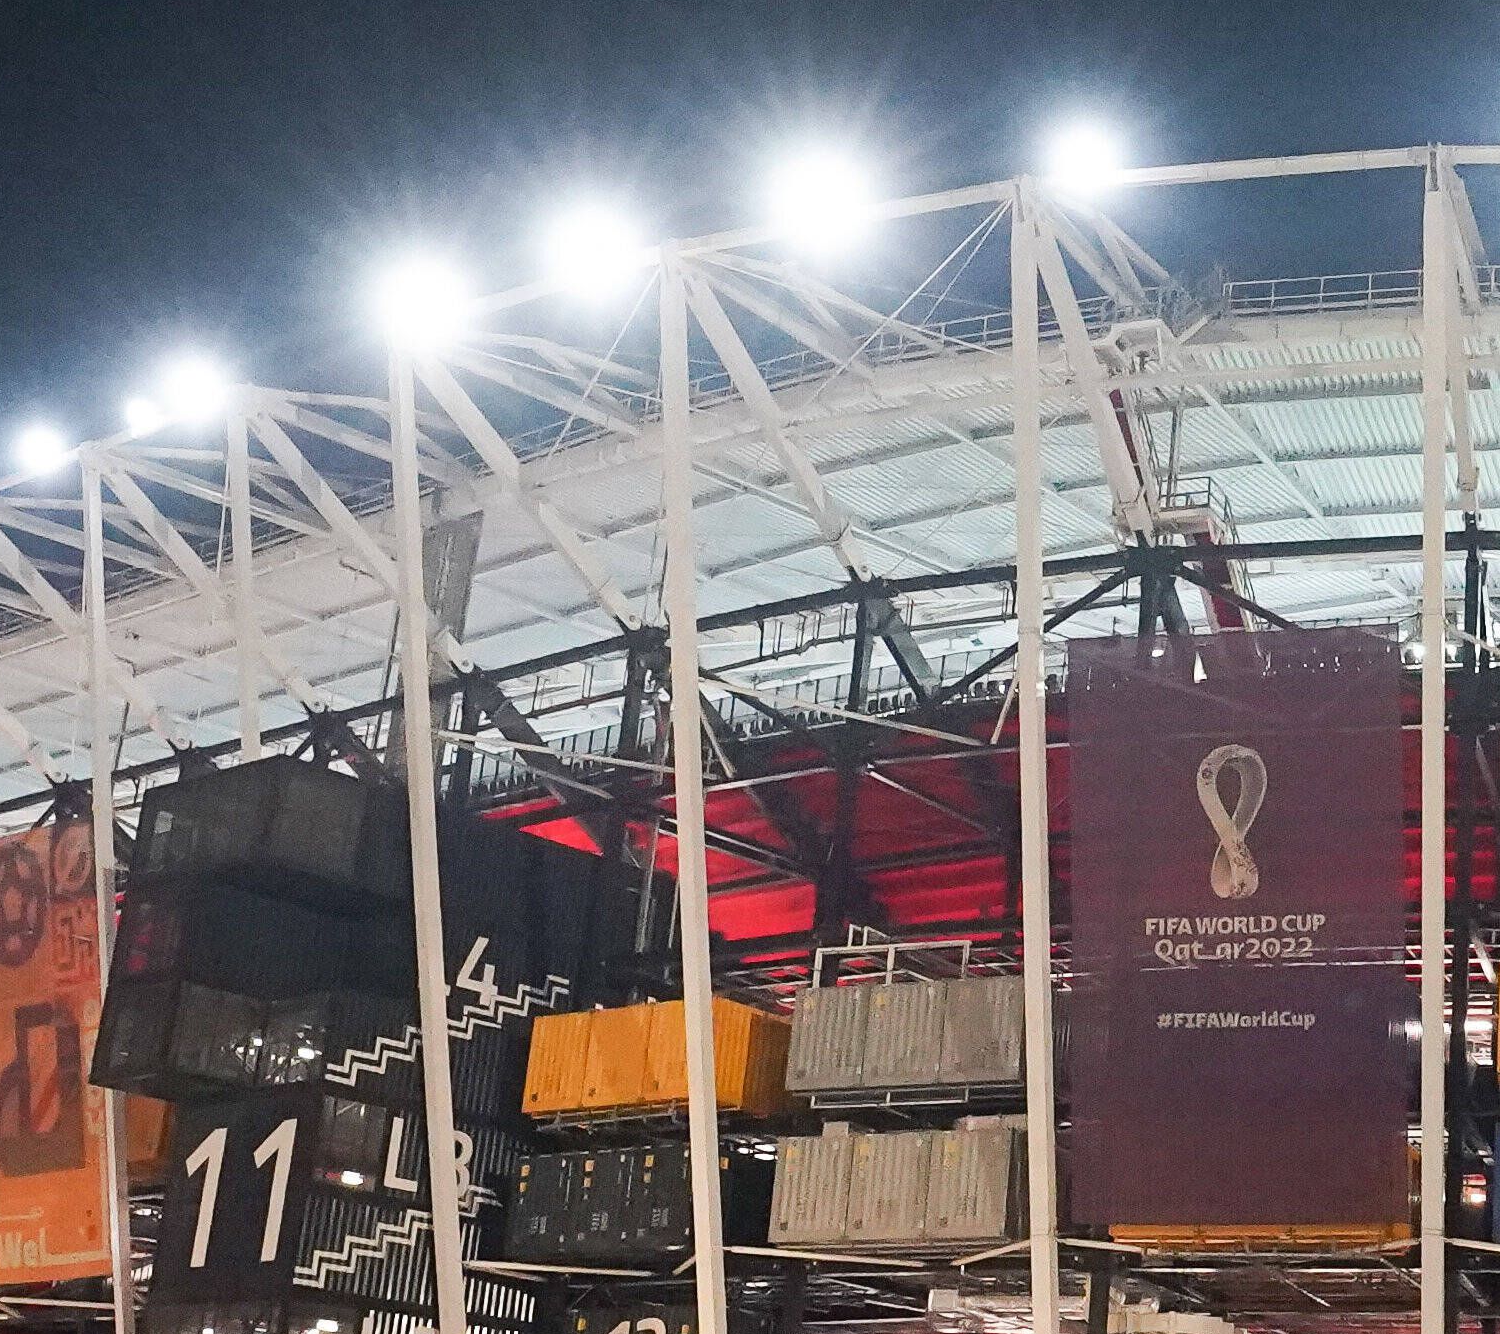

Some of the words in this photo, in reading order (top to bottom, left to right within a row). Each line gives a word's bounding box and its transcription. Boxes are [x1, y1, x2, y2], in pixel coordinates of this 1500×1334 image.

[1145, 917, 1192, 935] FIFA
[1196, 916, 1277, 935] WORLD
[1281, 914, 1326, 933] CUP
[1157, 1011, 1315, 1030] #FIFAWorldCup
[186, 1119, 297, 1267] 11
